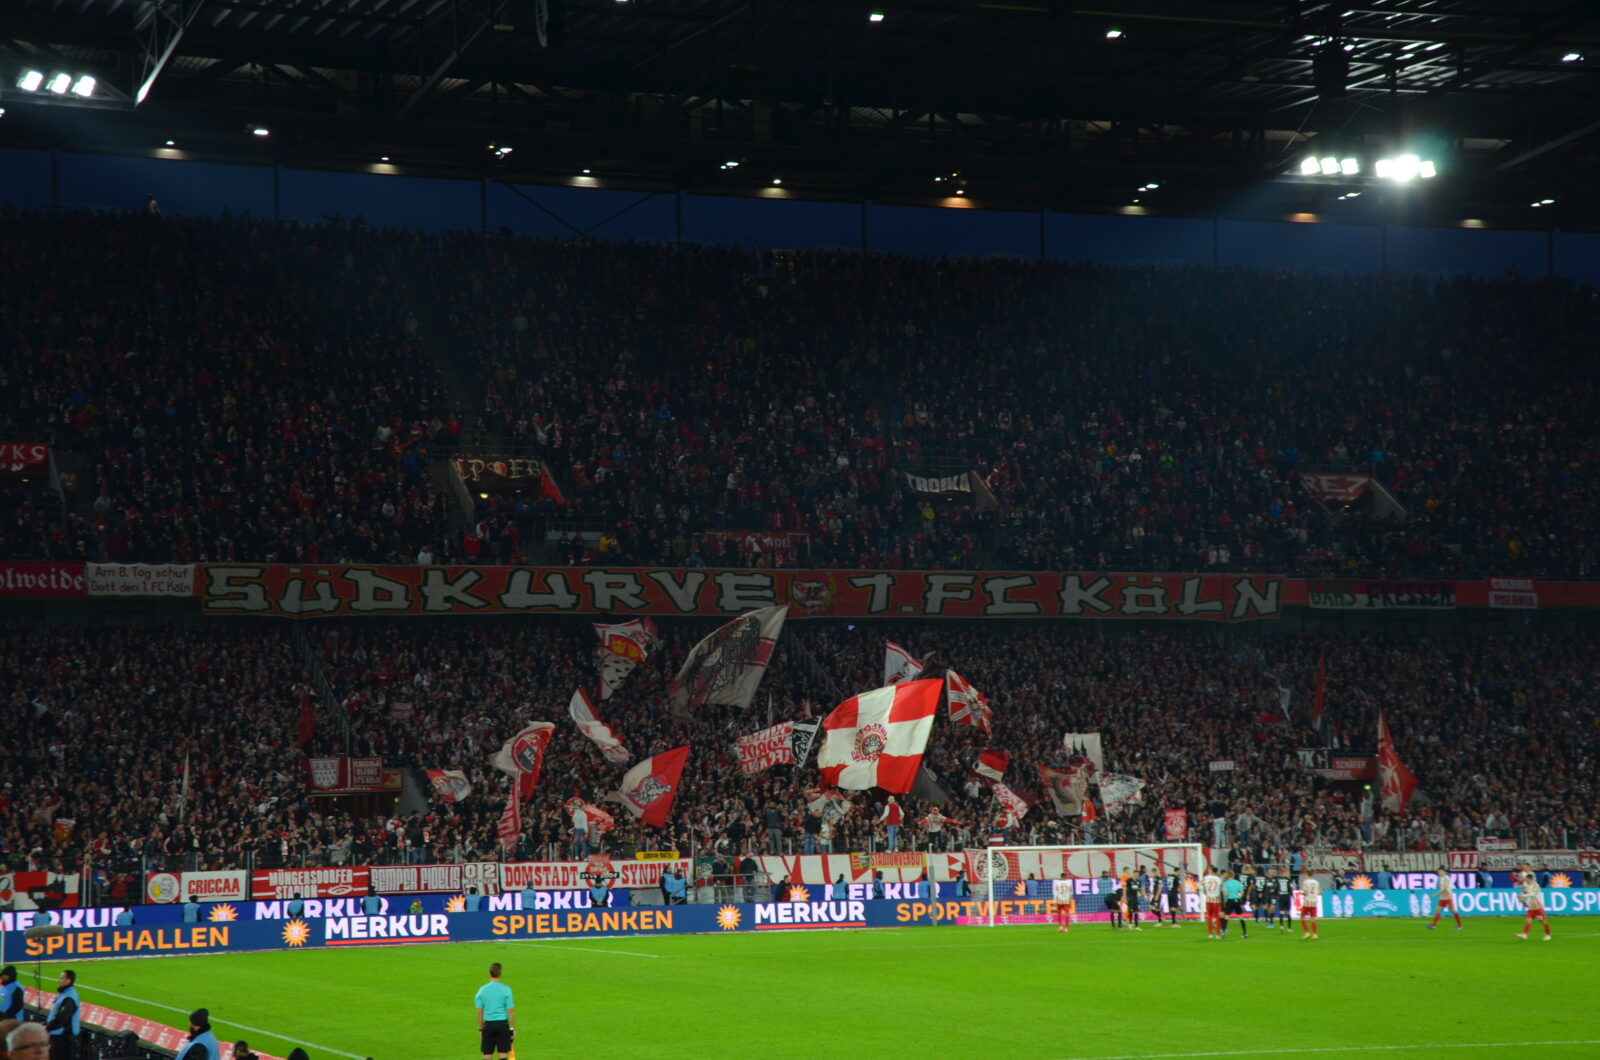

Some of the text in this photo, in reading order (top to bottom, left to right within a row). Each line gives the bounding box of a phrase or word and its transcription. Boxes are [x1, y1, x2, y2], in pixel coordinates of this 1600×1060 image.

[95, 567, 188, 580] Am 8. Tag schuf
[91, 581, 115, 592] Gott
[119, 581, 139, 592] den
[166, 582, 191, 593] Köln
[204, 566, 777, 614] SÜDKURVE
[1056, 574, 1281, 618] KÖLN
[269, 869, 354, 887] MÜNGERSDORFER
[505, 862, 689, 887] DOMSTADT SYNDIAT
[188, 879, 240, 895] CRICCAA
[491, 910, 674, 935] SPIELBANKEN
[754, 901, 866, 924] MERKUR
[324, 915, 450, 939] MERKUR
[25, 926, 229, 957] SPIELHALLEN
